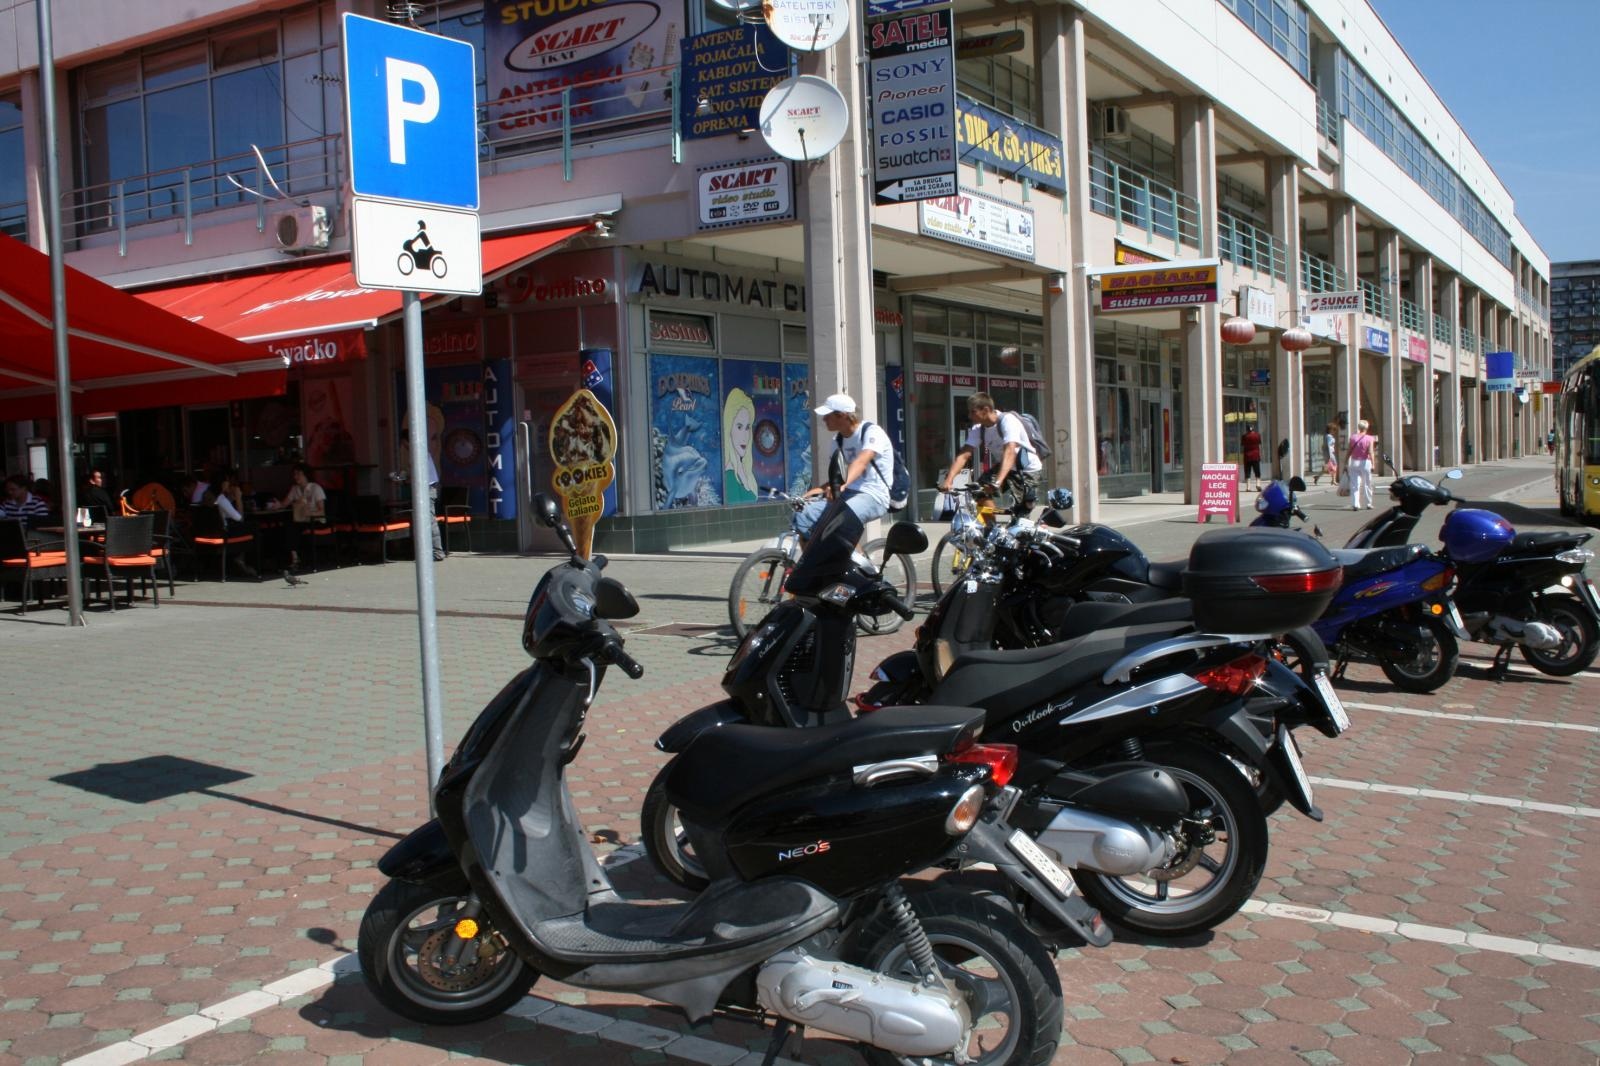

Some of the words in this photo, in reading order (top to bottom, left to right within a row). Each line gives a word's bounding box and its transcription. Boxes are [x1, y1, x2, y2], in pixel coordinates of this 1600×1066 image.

[501, 0, 607, 24] STUD
[530, 17, 626, 54] SCART
[692, 28, 743, 49] ANTENE
[872, 12, 948, 49] SATEL
[695, 42, 764, 66] POJAČALA
[906, 38, 948, 51] media
[698, 61, 757, 82] KABLOVI
[876, 57, 946, 82] SONY
[498, 64, 623, 105] ANTENSKI
[878, 84, 947, 103] Pioneer
[385, 57, 440, 165] P
[787, 106, 821, 117] SCART
[881, 102, 945, 125] CASIO
[693, 115, 748, 134] OPREMA
[880, 126, 949, 147] FOSSIL
[879, 147, 940, 170] swatch
[709, 167, 777, 192] SCART
[927, 182, 952, 190] ZGRADE
[639, 262, 777, 309] AUTOMAT
[1110, 295, 1152, 308] SLUŠNI
[1154, 293, 1208, 305] APARATI
[1320, 295, 1359, 306] SUNCE
[555, 463, 607, 488] COOKIES
[1201, 472, 1236, 480] NAOČALE
[569, 495, 597, 508] Gelato
[1205, 490, 1231, 498] SLUŠNI
[568, 504, 600, 518] italiano
[1012, 701, 1058, 733] Outlook
